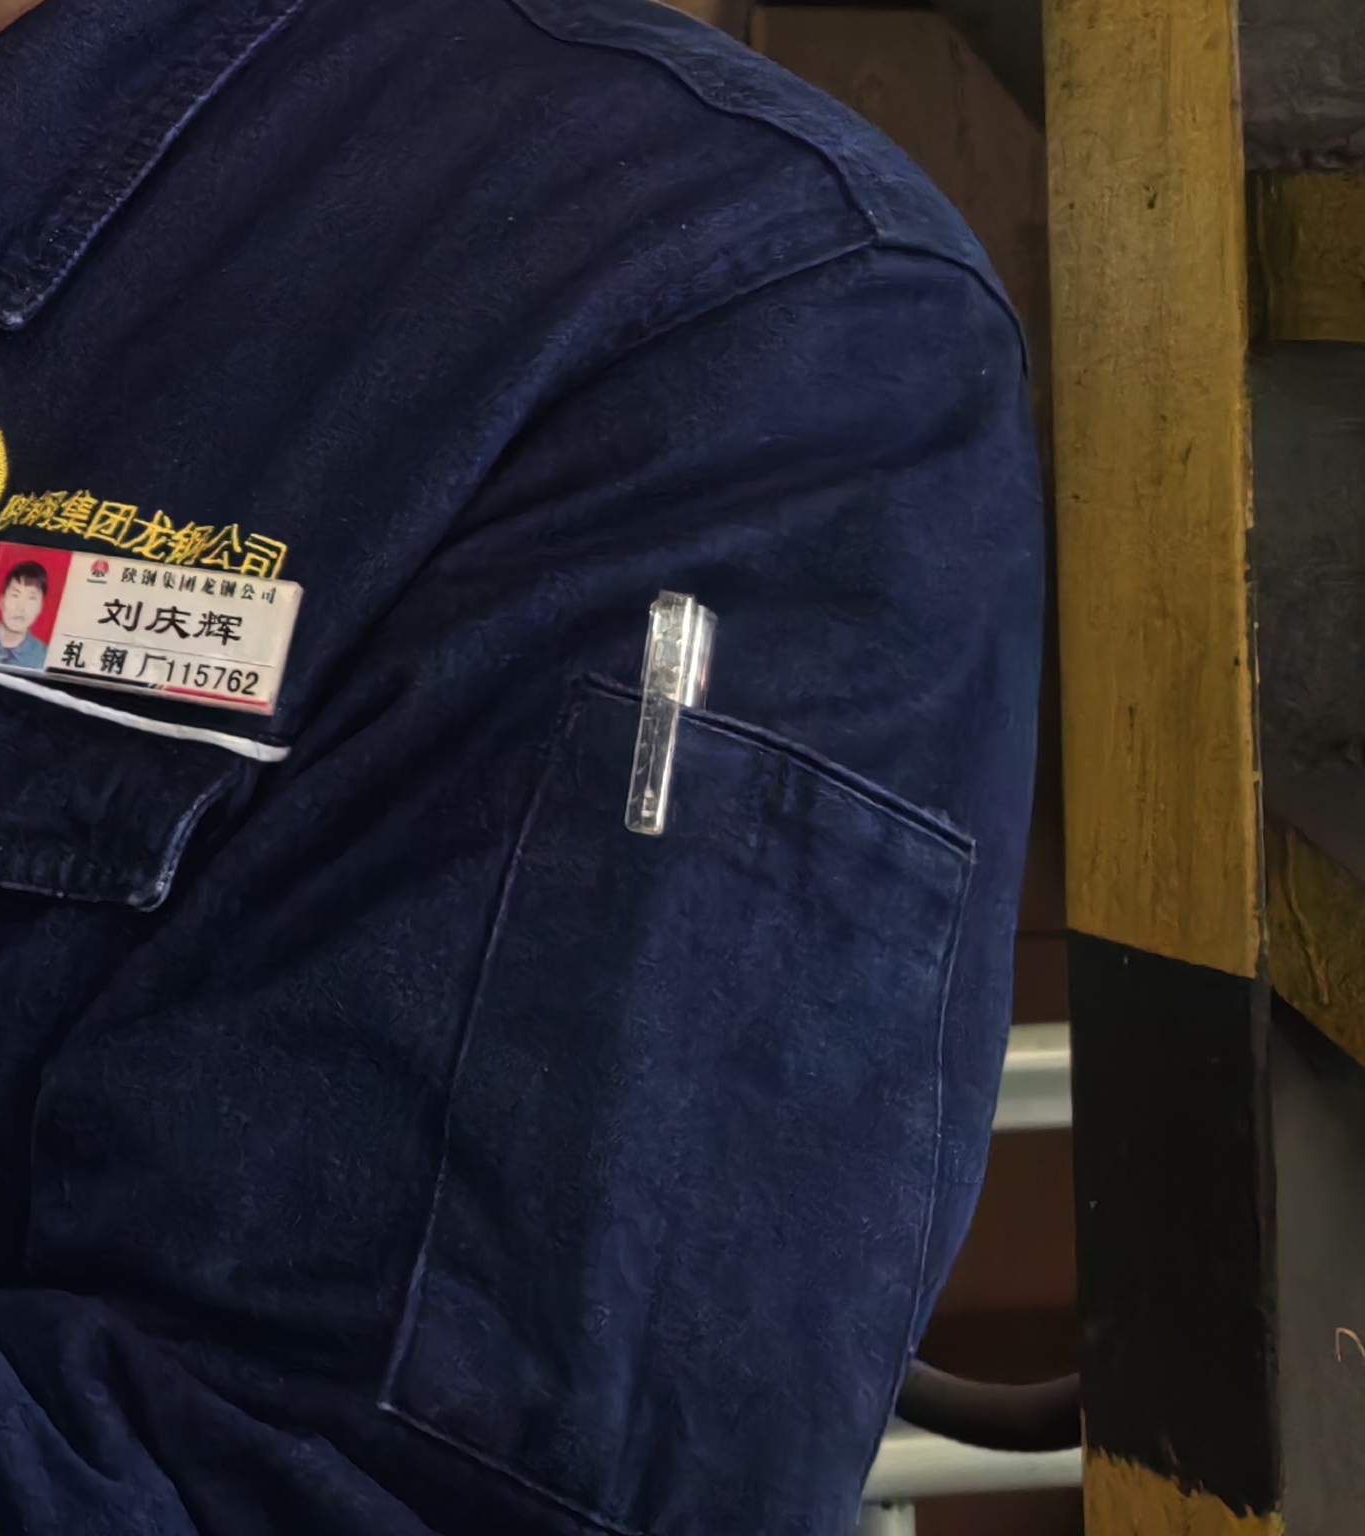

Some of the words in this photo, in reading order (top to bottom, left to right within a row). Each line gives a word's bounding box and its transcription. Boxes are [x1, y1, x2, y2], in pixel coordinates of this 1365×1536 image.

[121, 567, 277, 605] 陕钢集团龙钢公司
[98, 598, 243, 646] 刘庆辉
